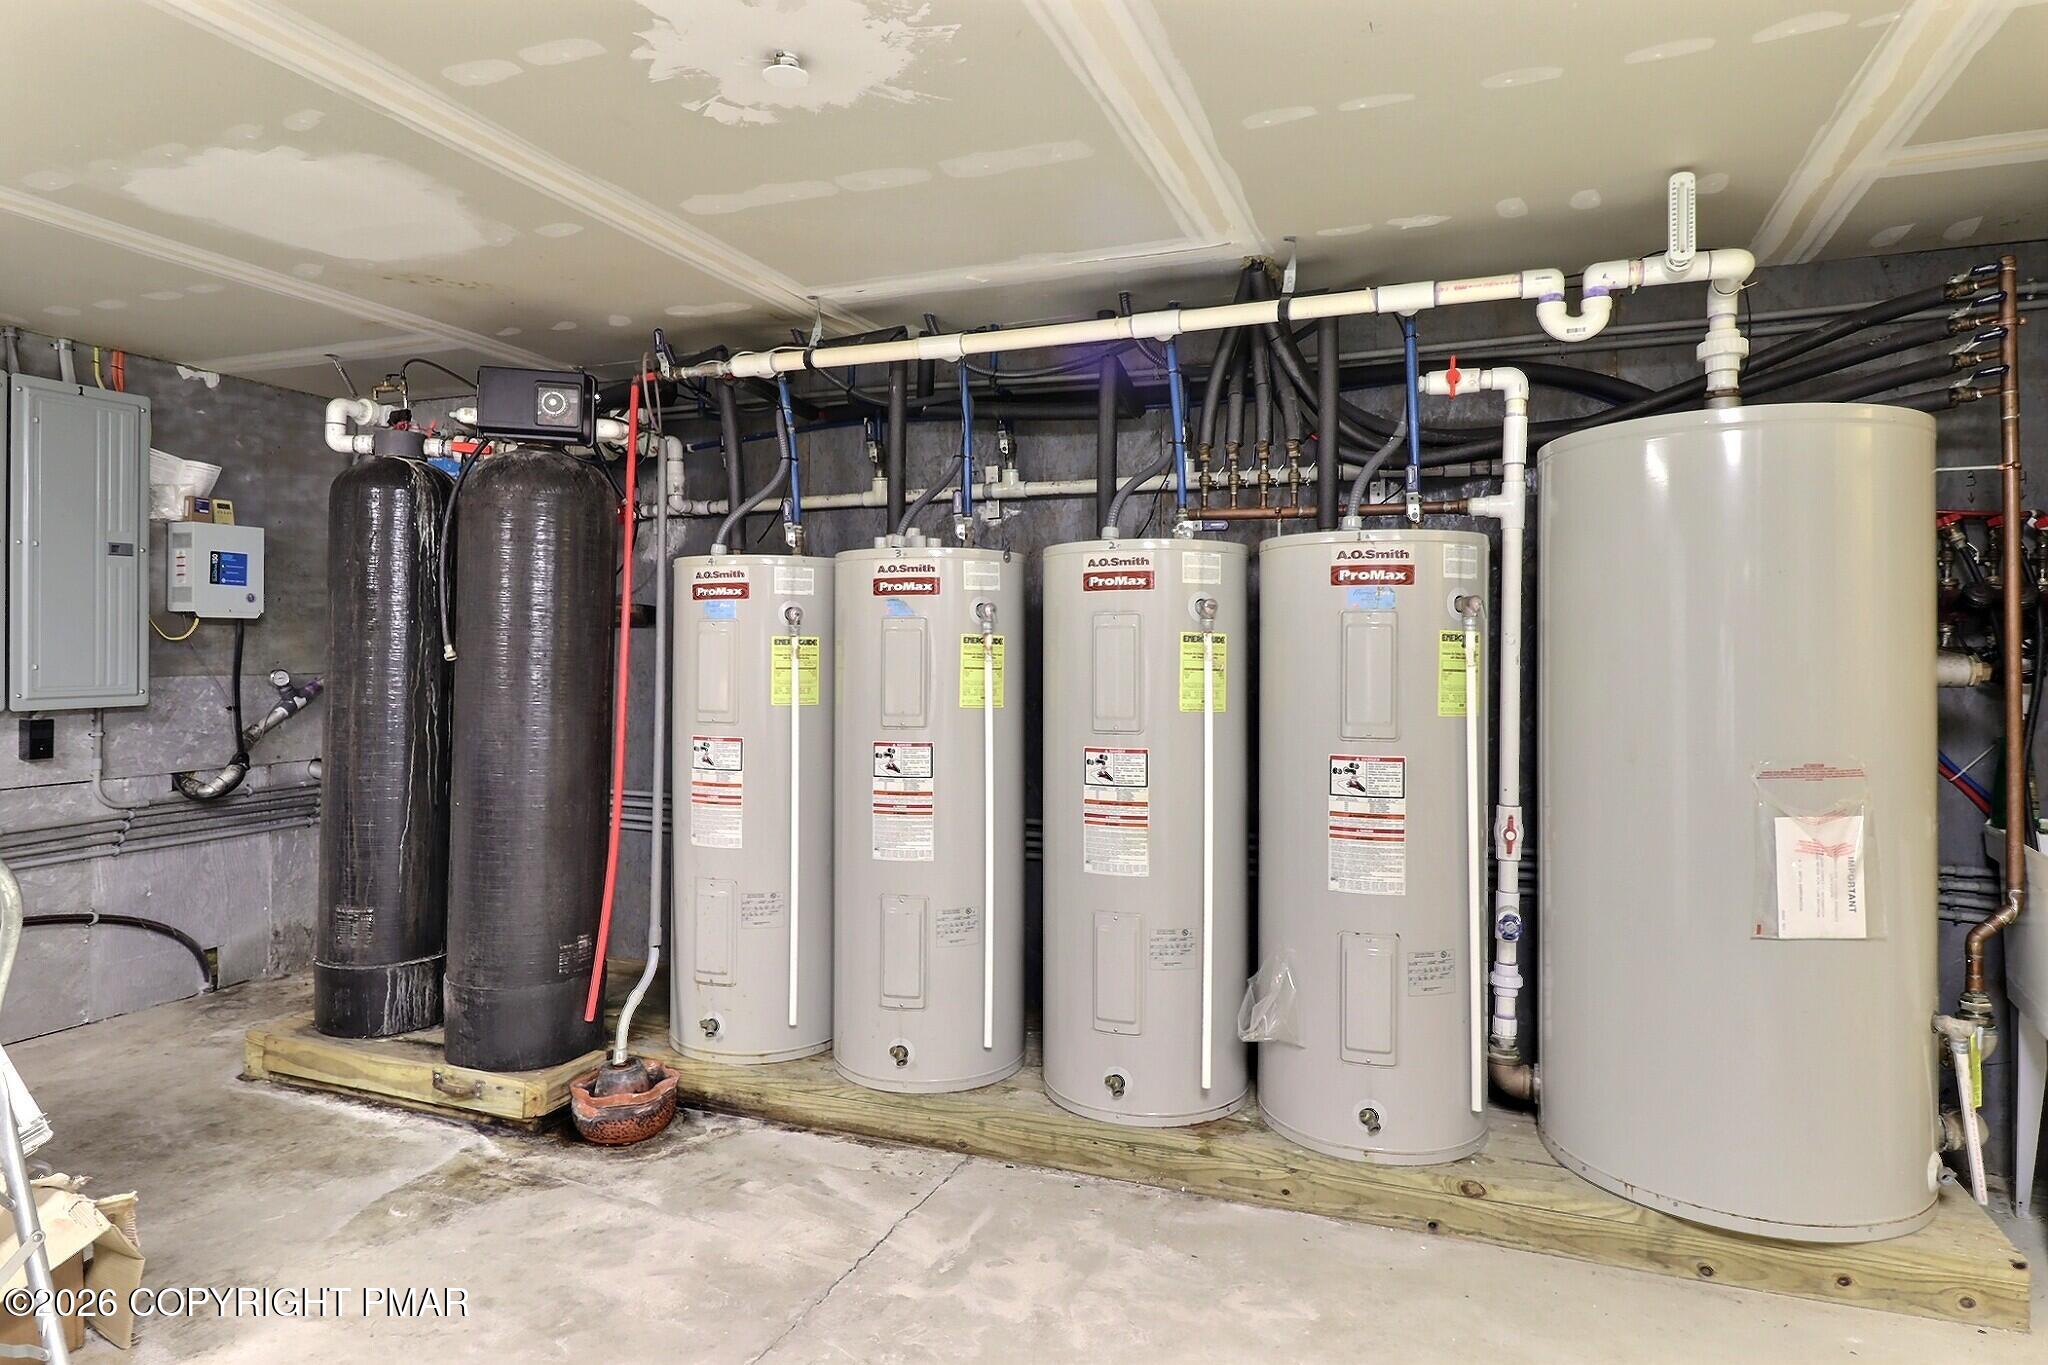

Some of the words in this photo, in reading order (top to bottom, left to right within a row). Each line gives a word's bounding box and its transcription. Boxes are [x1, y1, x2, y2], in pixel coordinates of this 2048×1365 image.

[78, 386, 84, 396] 1
[894, 549, 902, 558] 3
[1088, 575, 1147, 587] ProMax
[1338, 569, 1407, 582] ProMax
[696, 586, 744, 598] ProMax
[878, 581, 934, 593] ProMax
[1847, 856, 1857, 914] IMPORTANT
